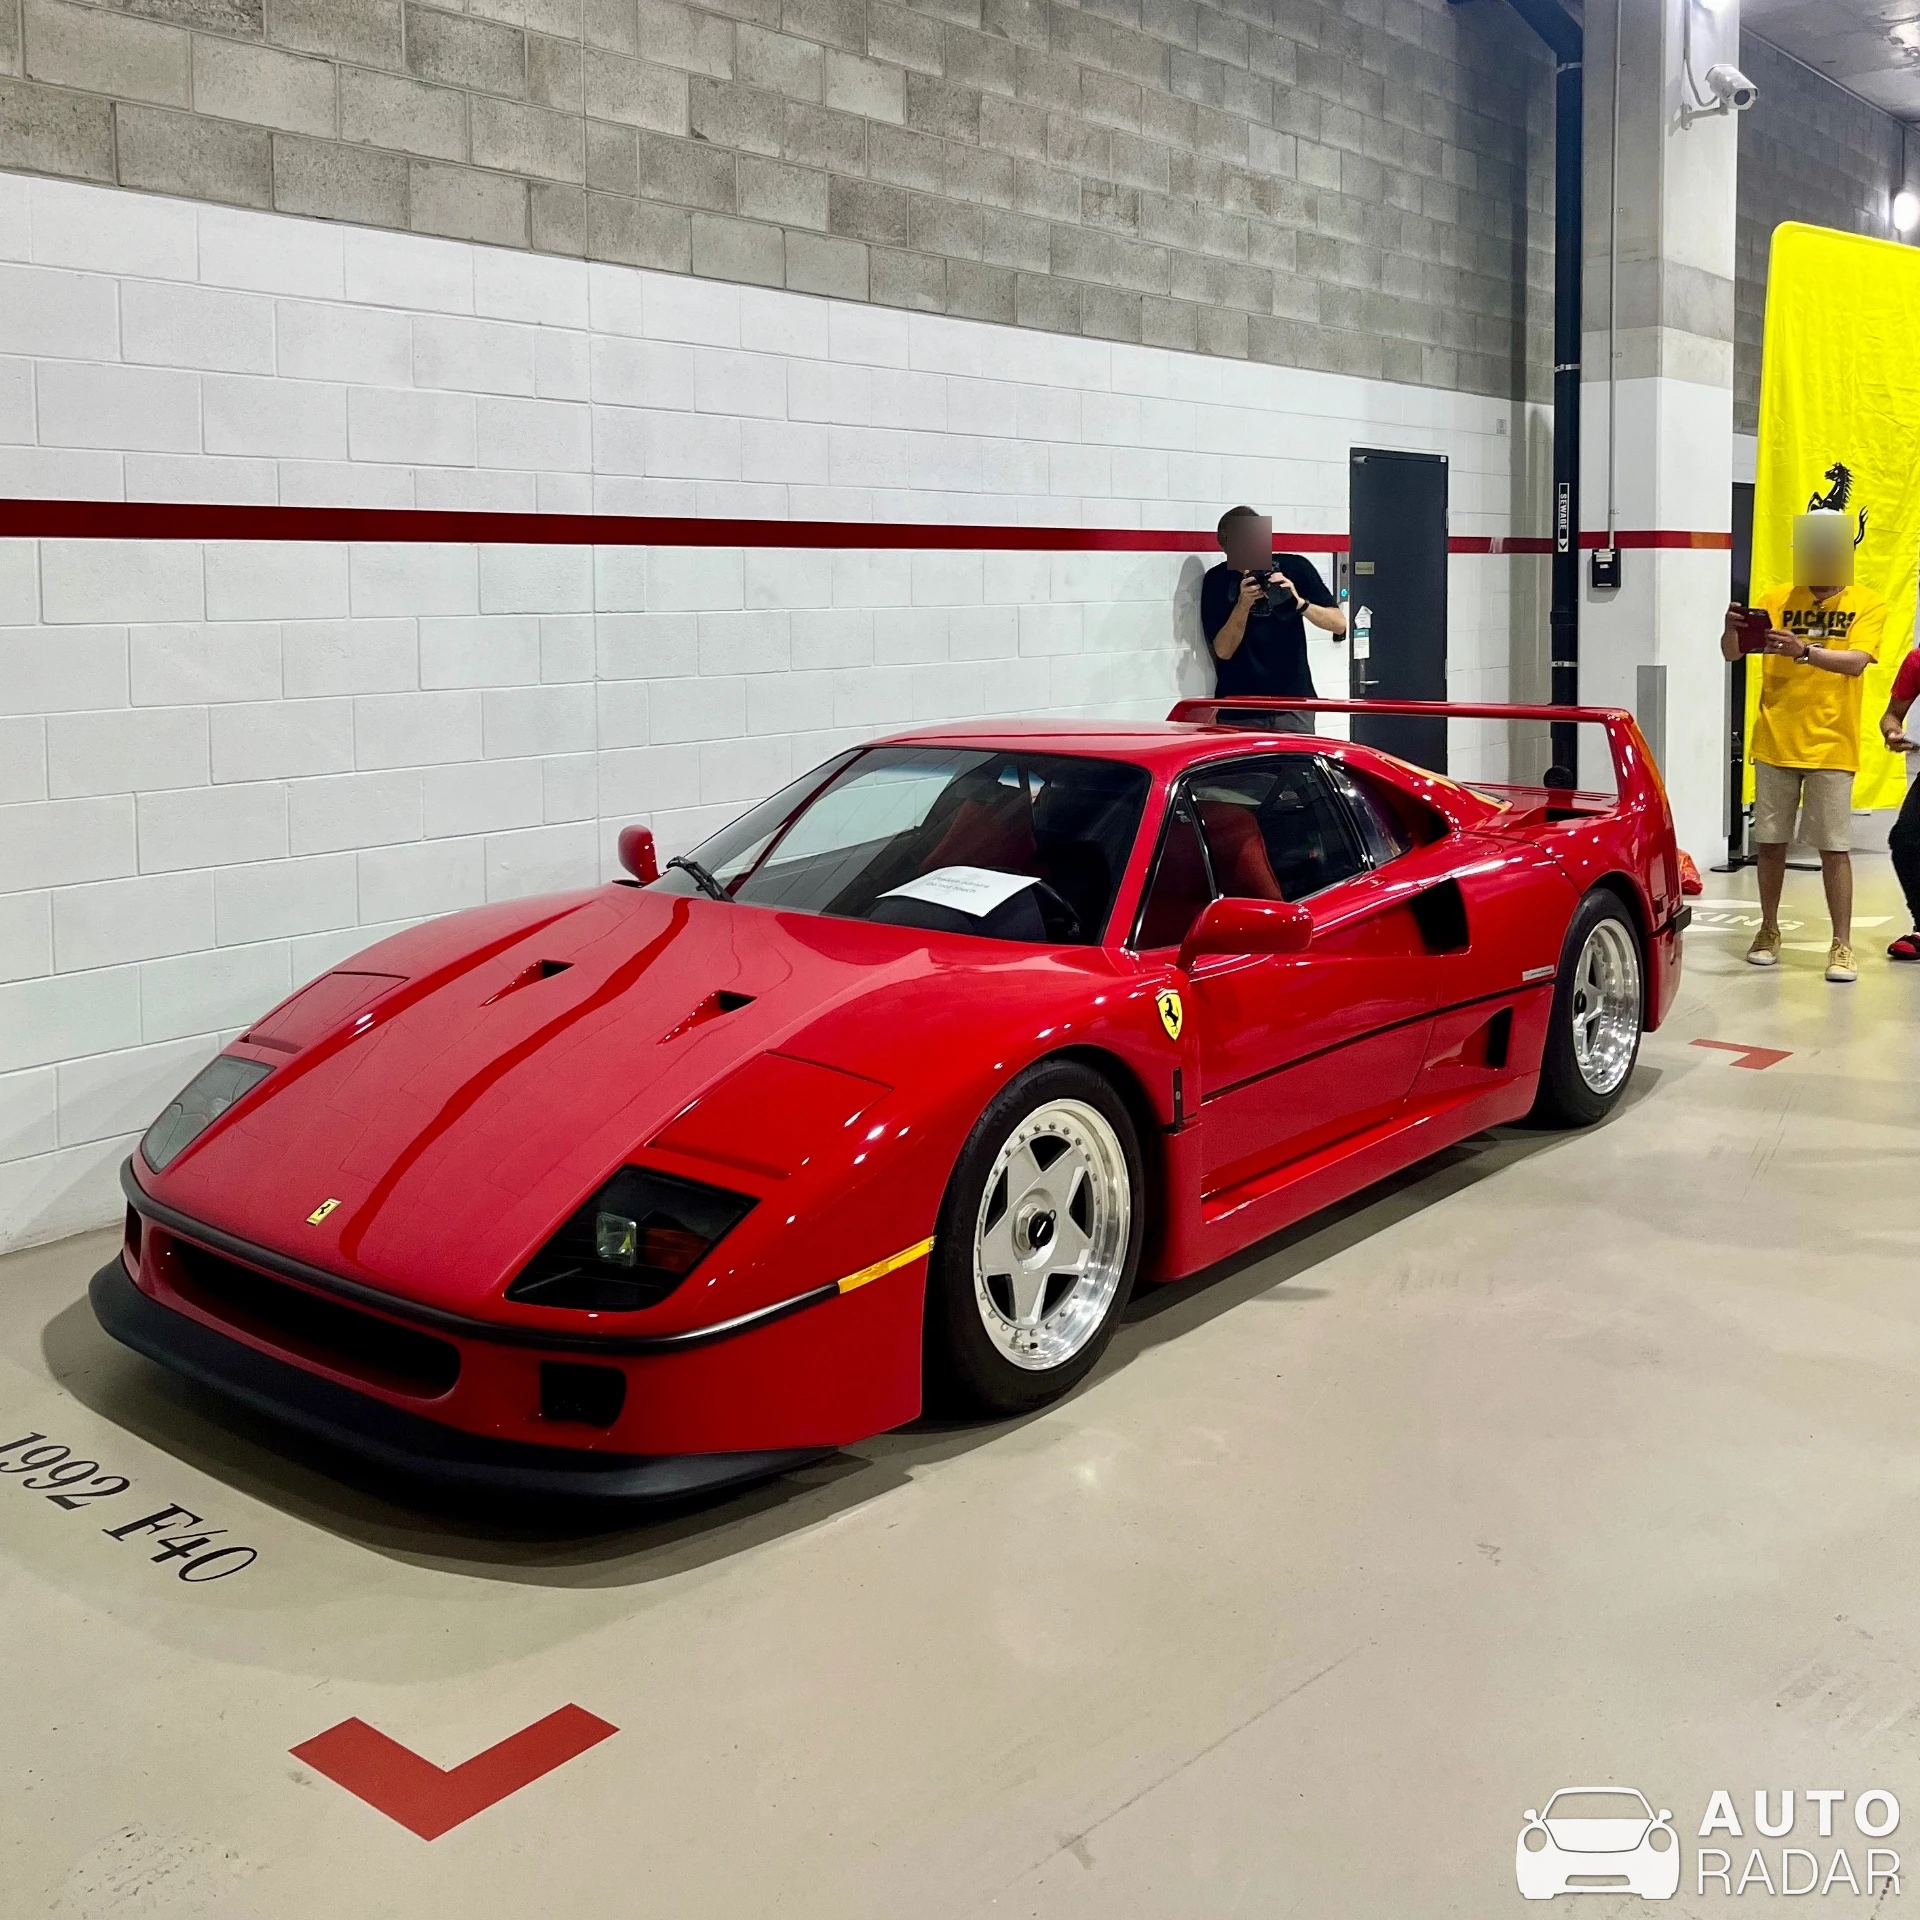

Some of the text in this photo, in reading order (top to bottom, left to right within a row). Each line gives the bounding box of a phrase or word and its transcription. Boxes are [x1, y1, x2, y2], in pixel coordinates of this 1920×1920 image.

[1783, 610, 1856, 628] PACKERS
[0, 1432, 257, 1582] 1992 F40
